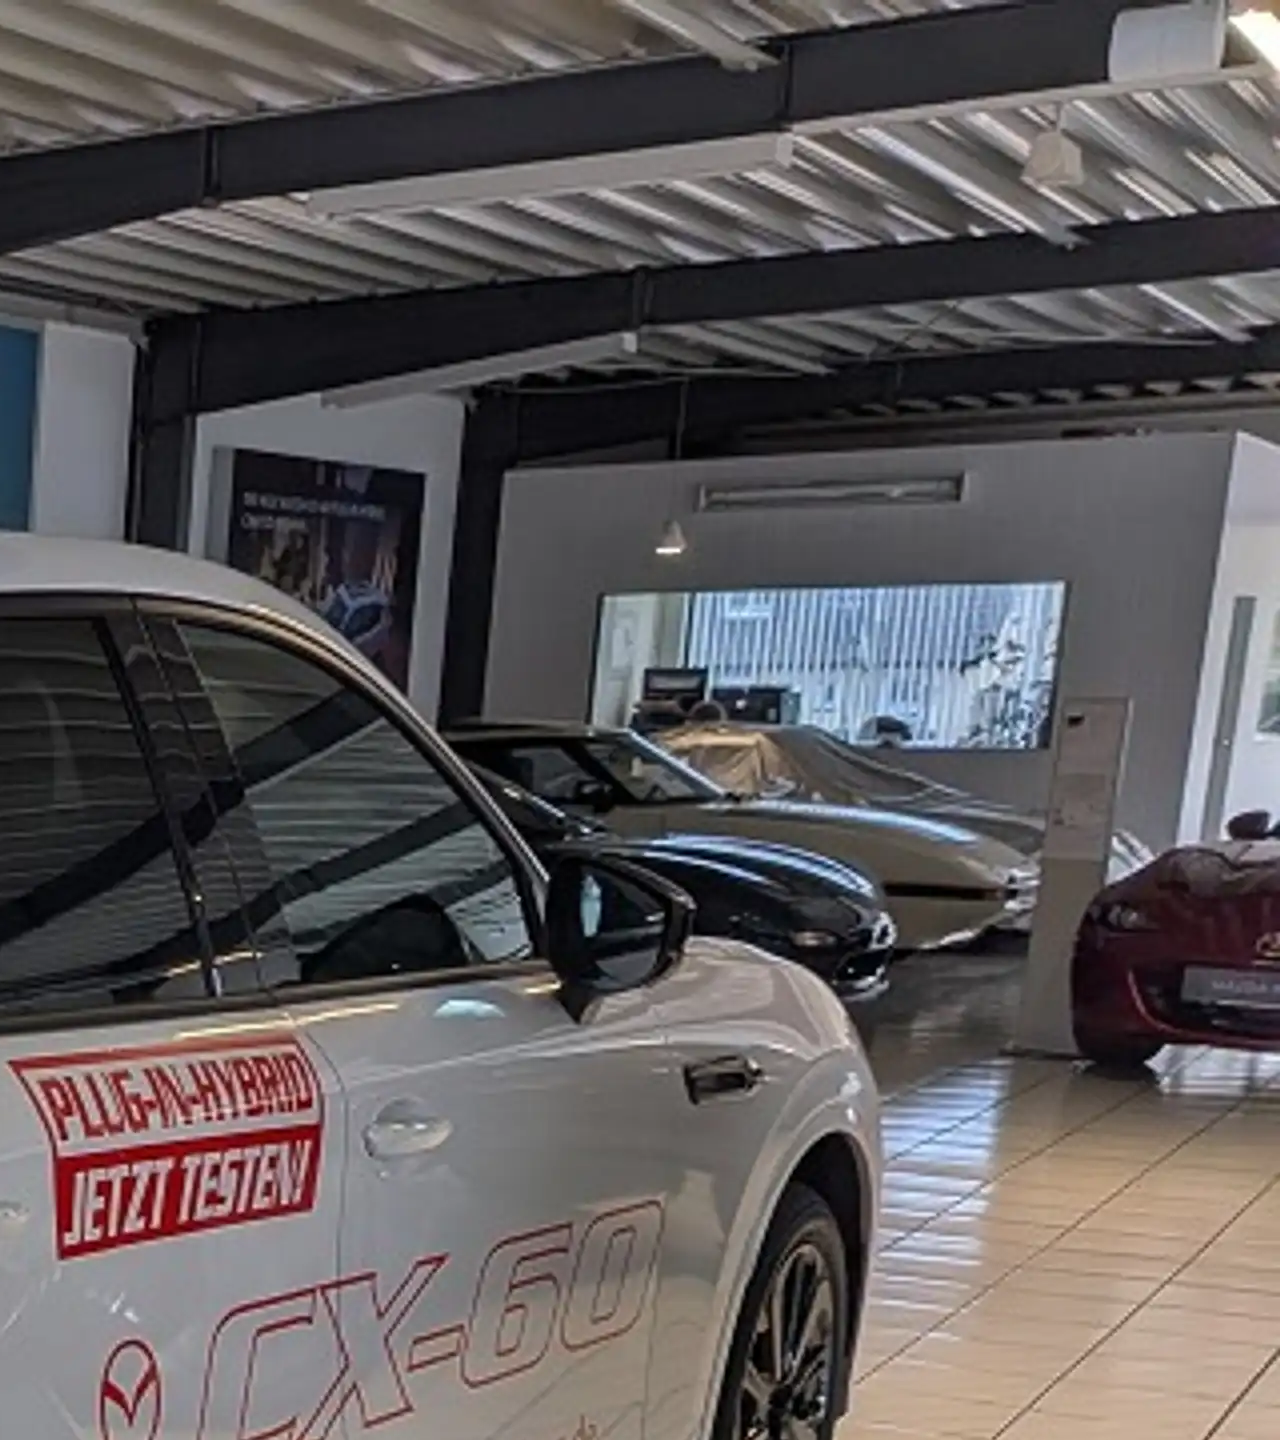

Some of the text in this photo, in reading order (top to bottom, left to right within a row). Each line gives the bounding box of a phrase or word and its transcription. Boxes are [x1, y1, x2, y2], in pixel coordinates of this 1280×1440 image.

[37, 1052, 314, 1142] PLUG-IN-HYBRID
[62, 1139, 313, 1246] JETZT TESTEN!
